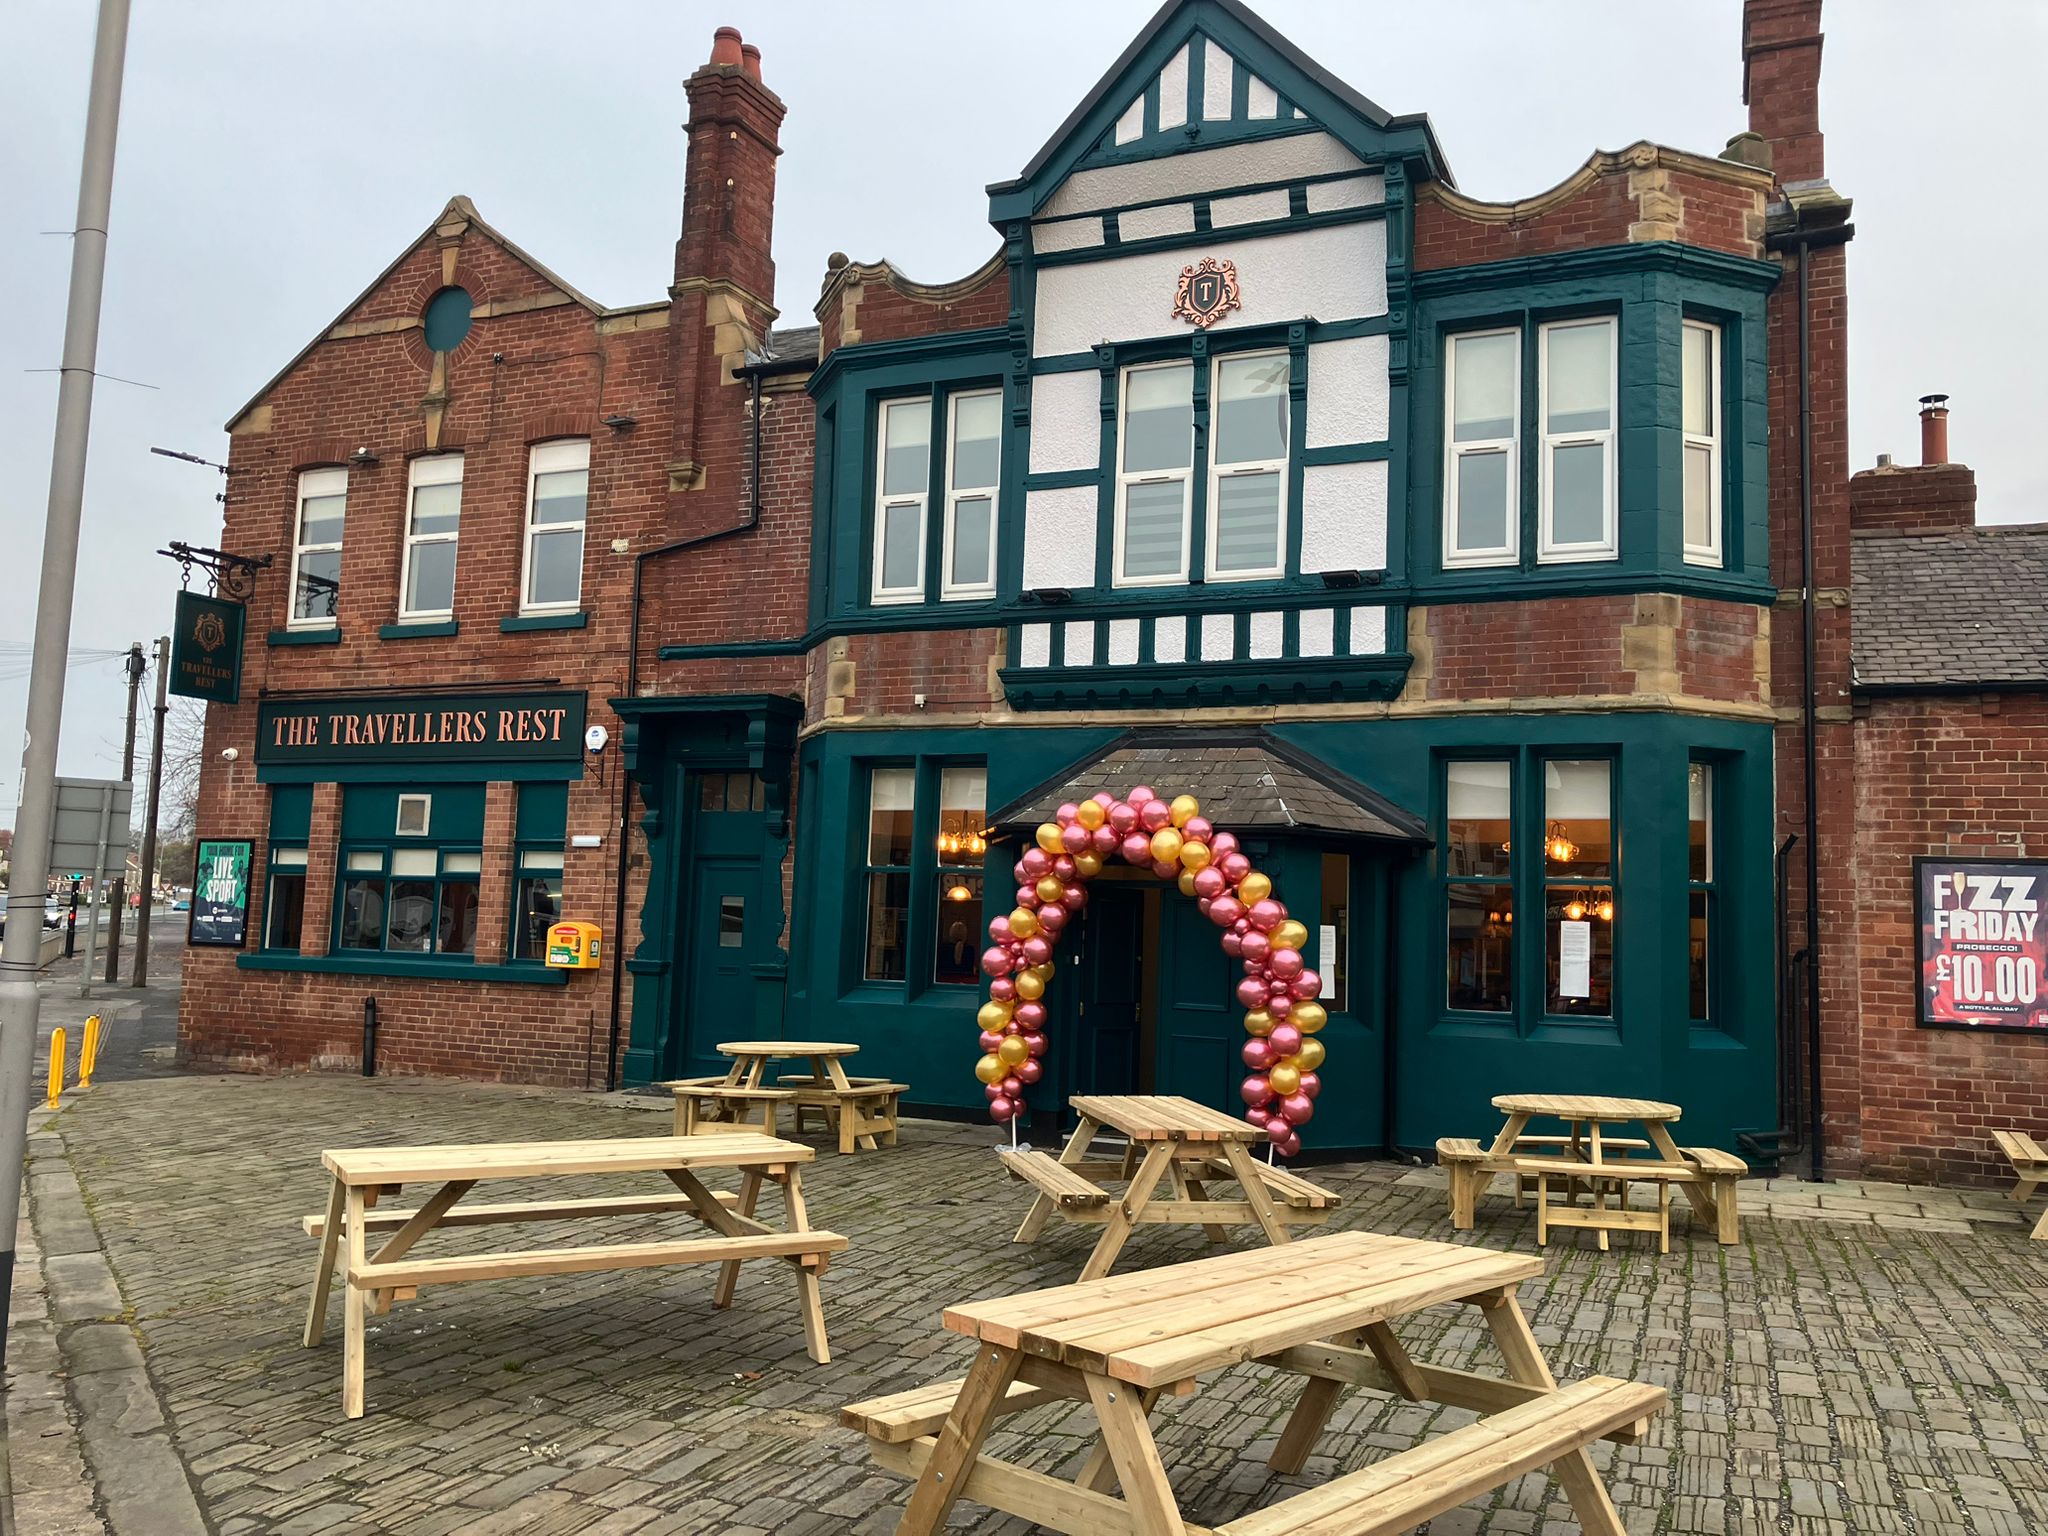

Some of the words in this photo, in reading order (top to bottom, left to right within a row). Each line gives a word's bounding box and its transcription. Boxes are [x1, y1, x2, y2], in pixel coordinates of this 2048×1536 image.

[1200, 282, 1212, 301] T
[208, 627, 214, 637] T
[181, 662, 232, 679] TRAVELLERS
[272, 715, 320, 746] THE
[328, 710, 487, 745] TRAVELLERS
[496, 708, 567, 742] REST
[213, 857, 234, 879] LIVE
[205, 879, 238, 903] SPORT
[1933, 909, 2039, 942] FRIDAY
[1956, 943, 2018, 952] PROSECCO!
[1936, 954, 2037, 1004] £10.00
